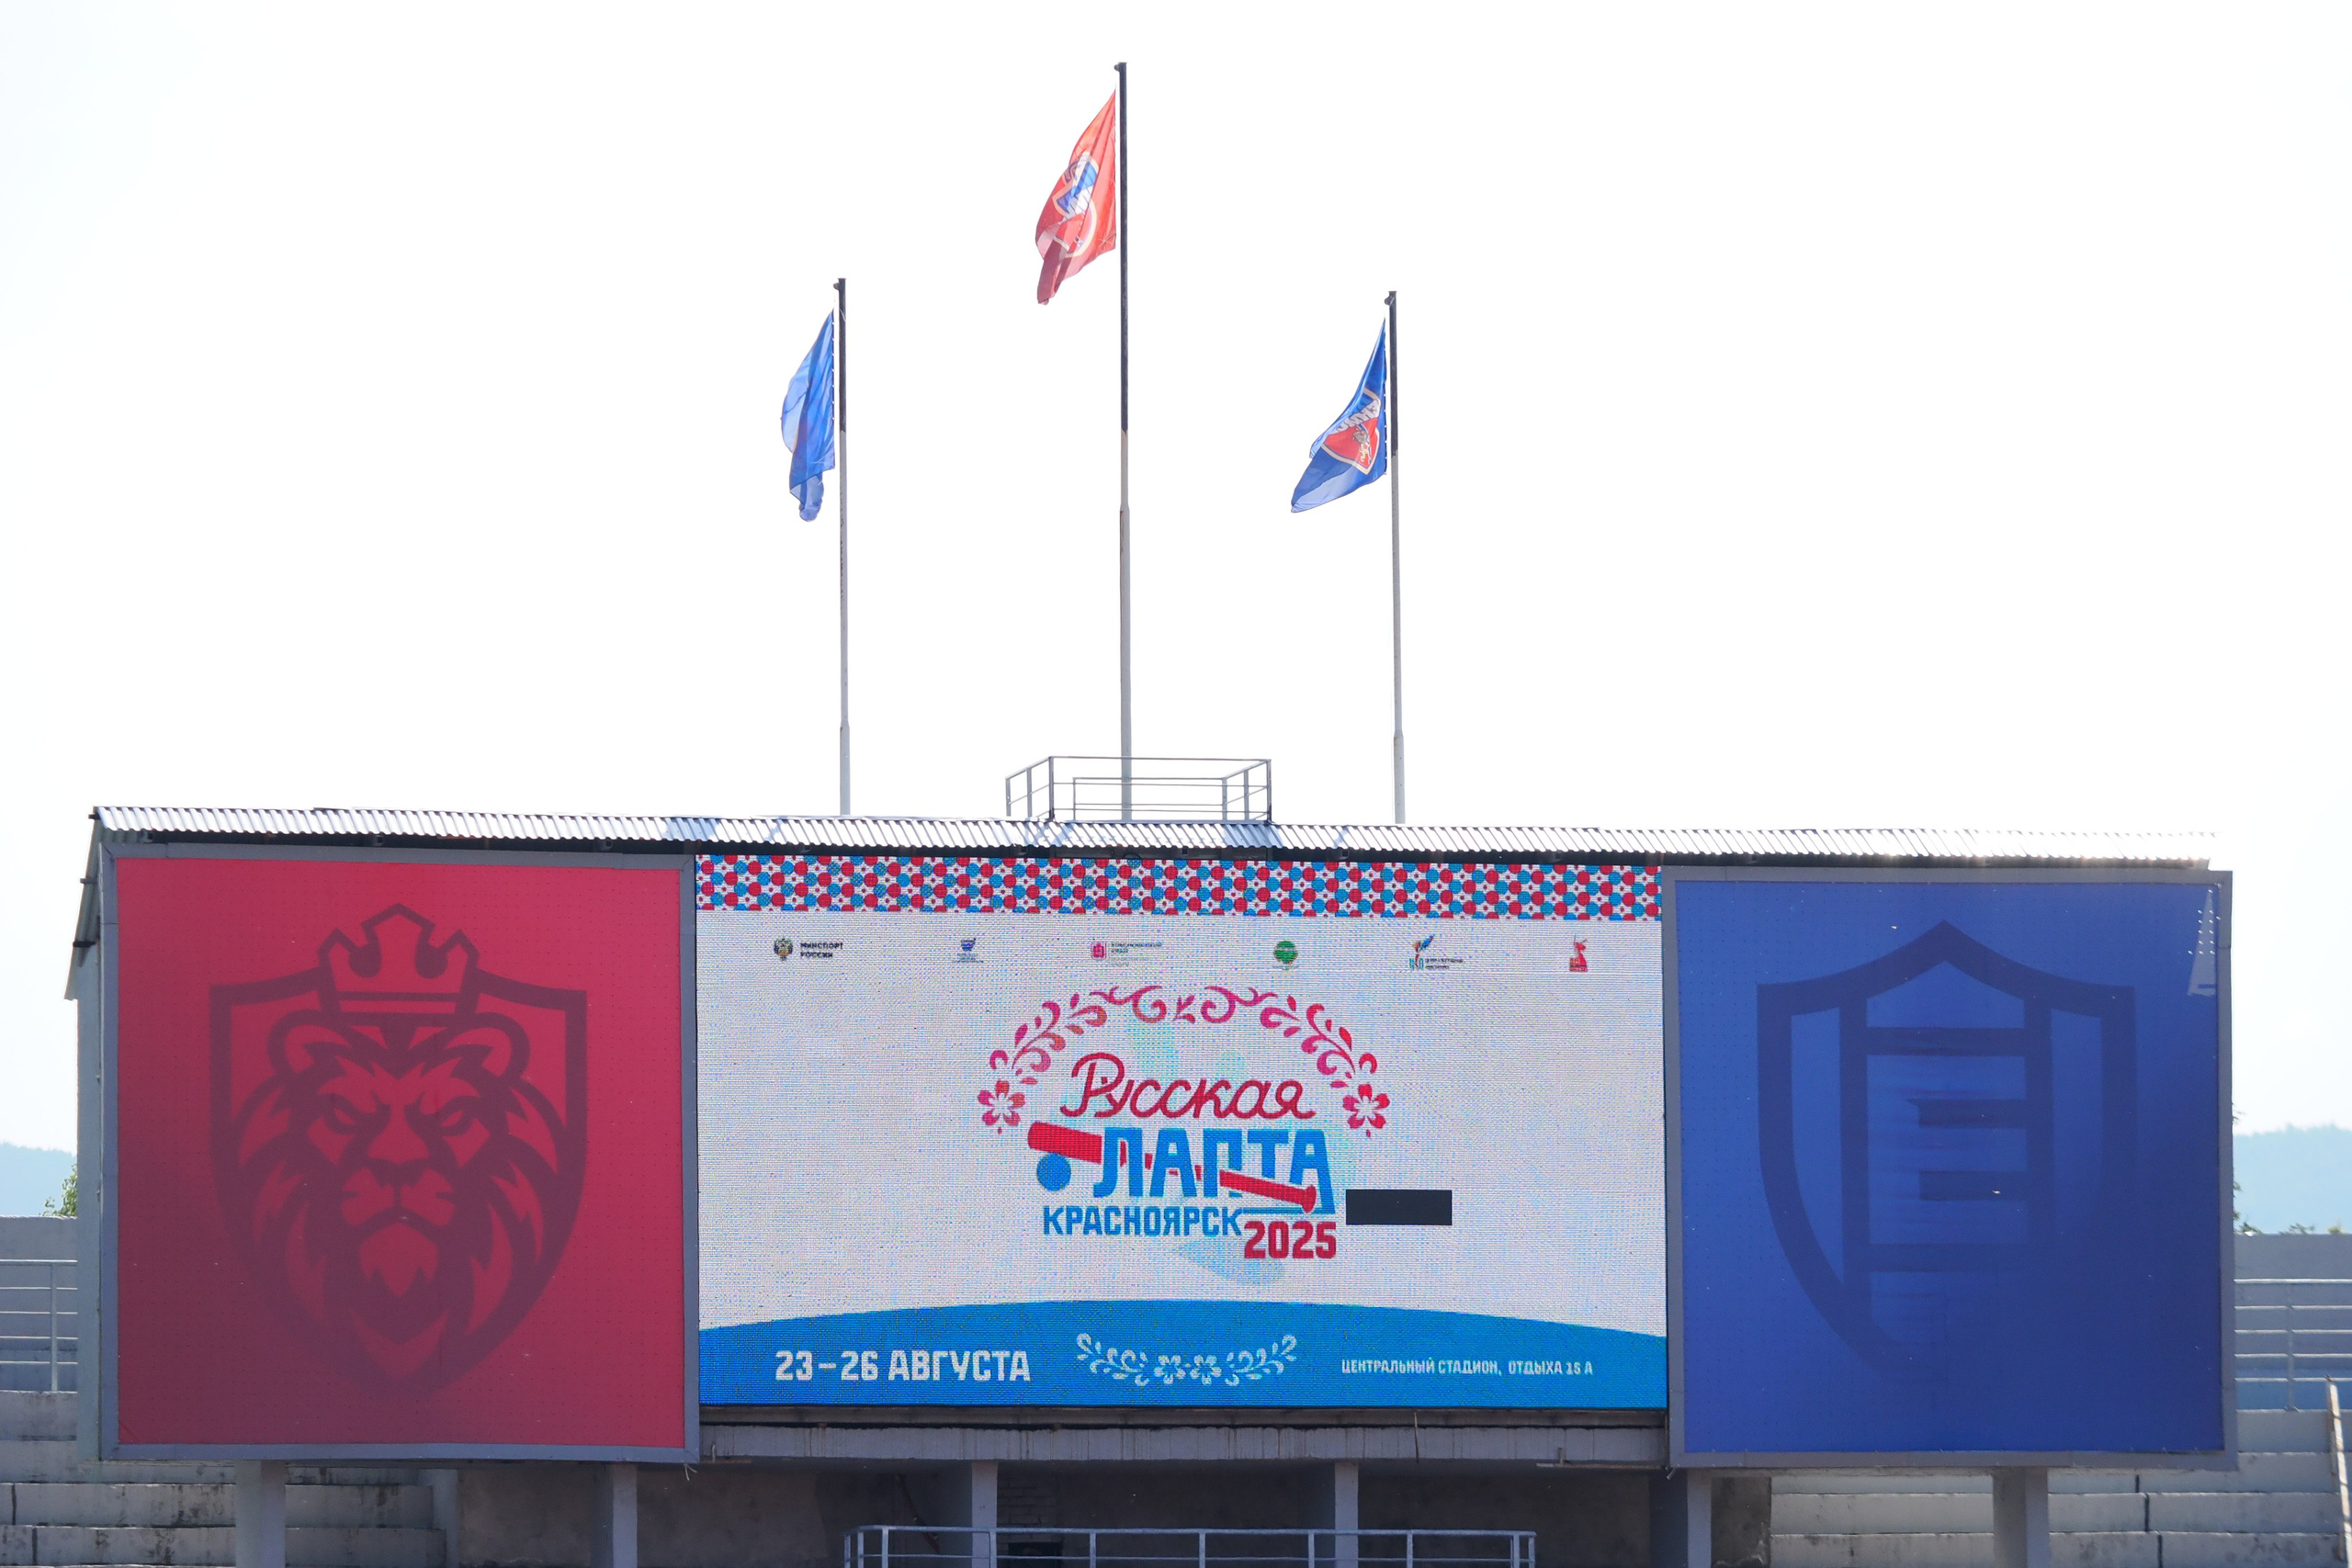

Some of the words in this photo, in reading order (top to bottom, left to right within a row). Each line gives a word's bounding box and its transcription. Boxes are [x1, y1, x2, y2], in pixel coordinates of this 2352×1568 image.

[1059, 1052, 1316, 1120] Русская
[1093, 1127, 1336, 1214] ЛАПТА
[1044, 1206, 1242, 1236] КРАСНОЯРСК
[1243, 1222, 1337, 1259] 2025
[888, 1350, 1031, 1382] АВГУСТА
[1341, 1357, 1435, 1374] ЦЕНТРАЛЬНЫЙ
[1438, 1359, 1502, 1375] СТАДИОН,
[1508, 1360, 1563, 1375] ОТДЫХА
